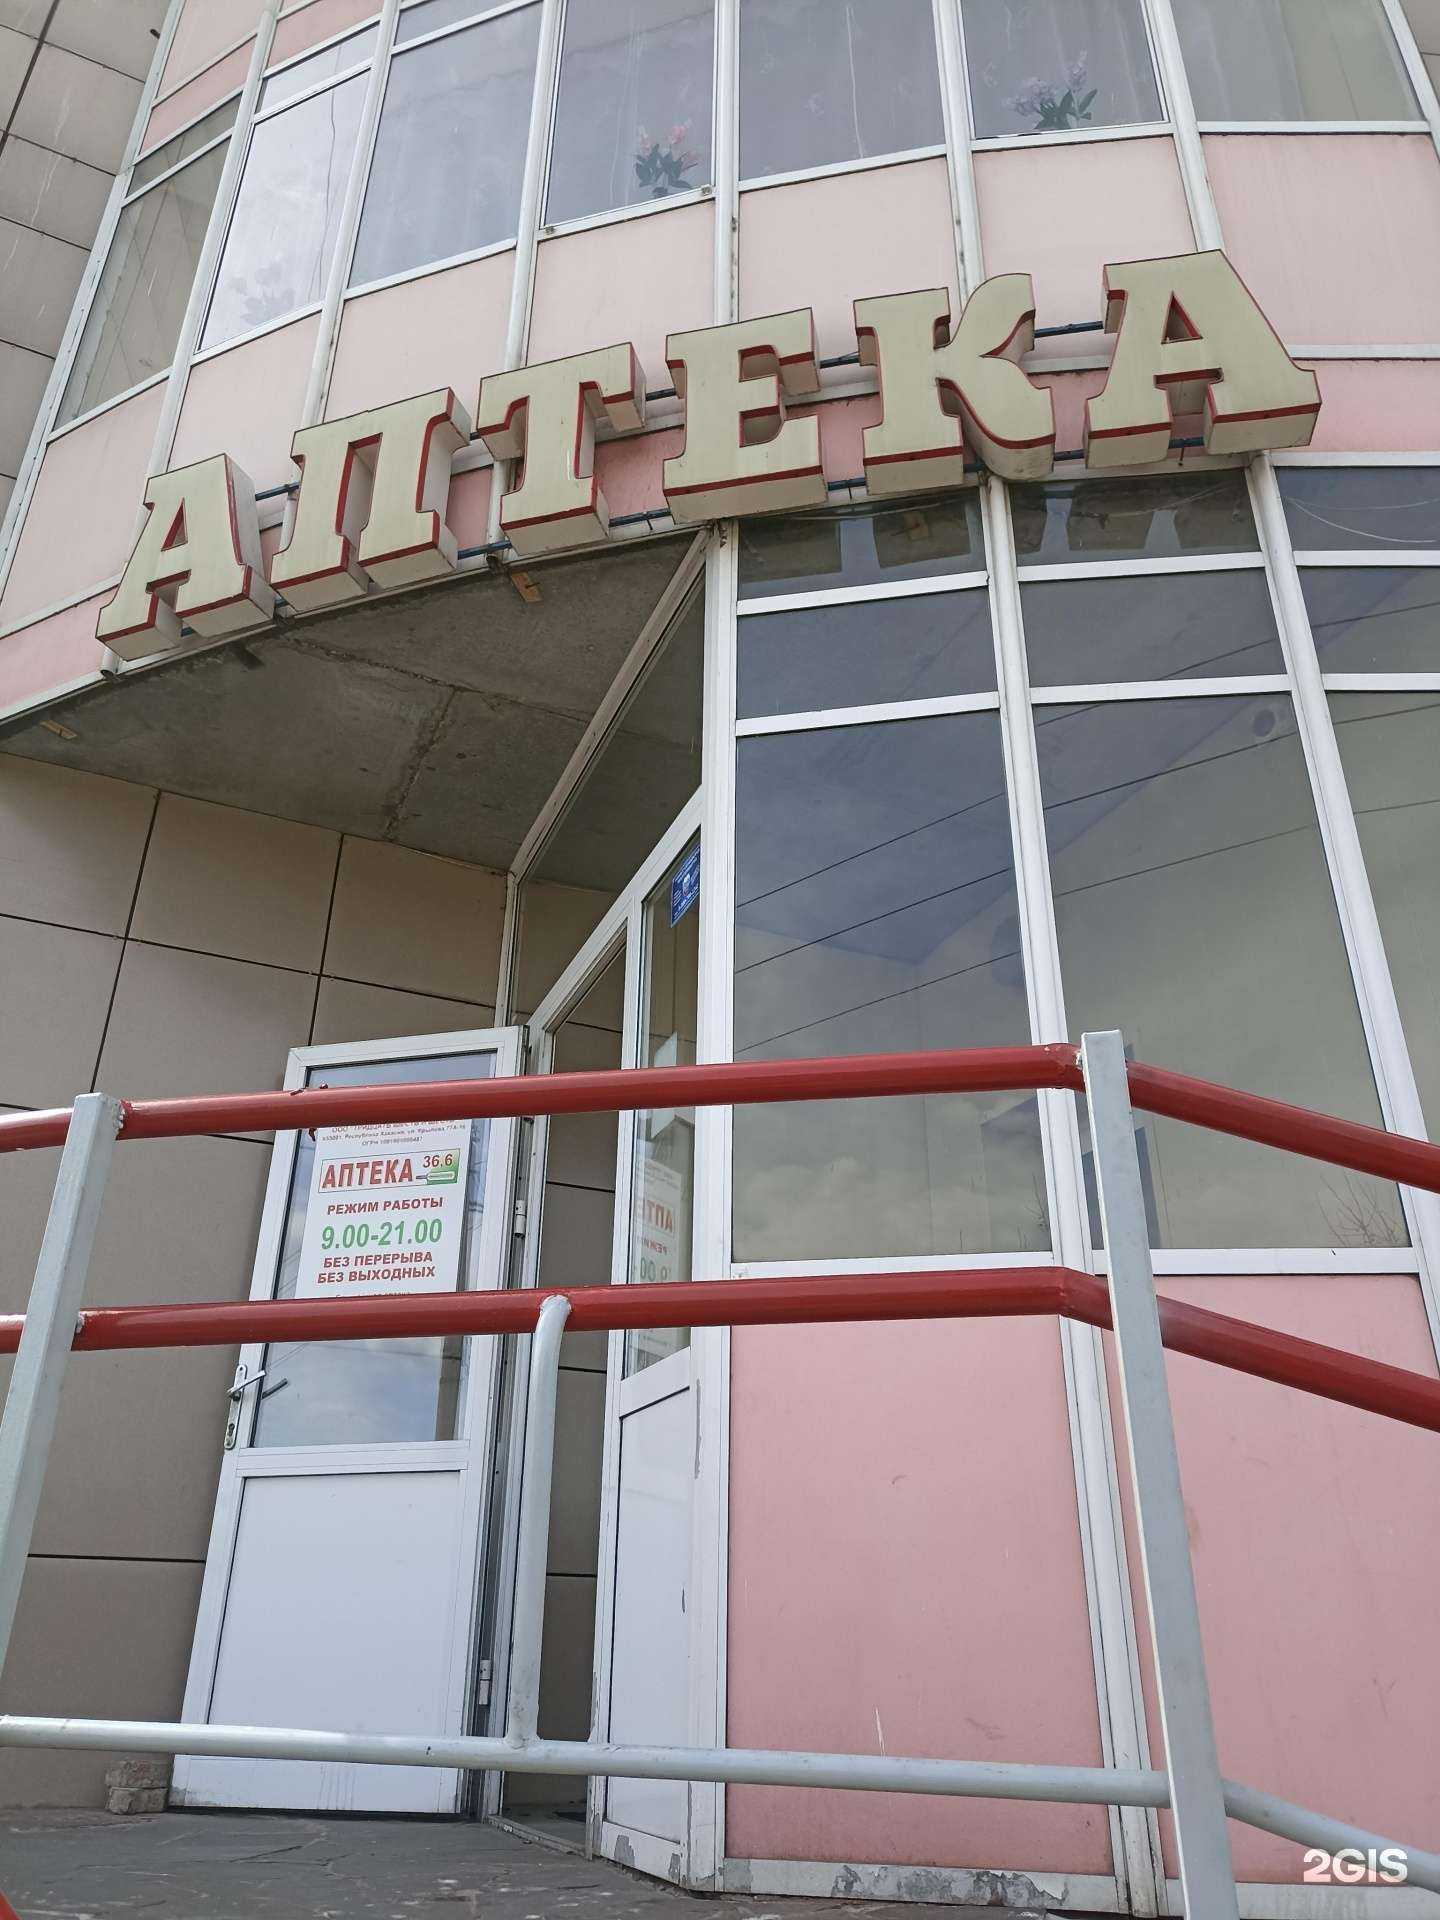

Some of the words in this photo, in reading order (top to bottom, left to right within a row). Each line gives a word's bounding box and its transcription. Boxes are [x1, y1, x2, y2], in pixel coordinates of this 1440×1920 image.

[96, 249, 1321, 648] АПТЕКА
[321, 1158, 413, 1189] АПТЕКА
[327, 1201, 379, 1215] РЕЖИМ
[383, 1197, 443, 1211] РАБОТЫ
[321, 1218, 443, 1250] 9.00-21.00
[323, 1256, 350, 1268] БЕЗ
[354, 1252, 433, 1266] ПЕРЕРЫВА
[317, 1272, 344, 1284] БЕЗ
[348, 1266, 436, 1281] ВЫХОДНЫХ
